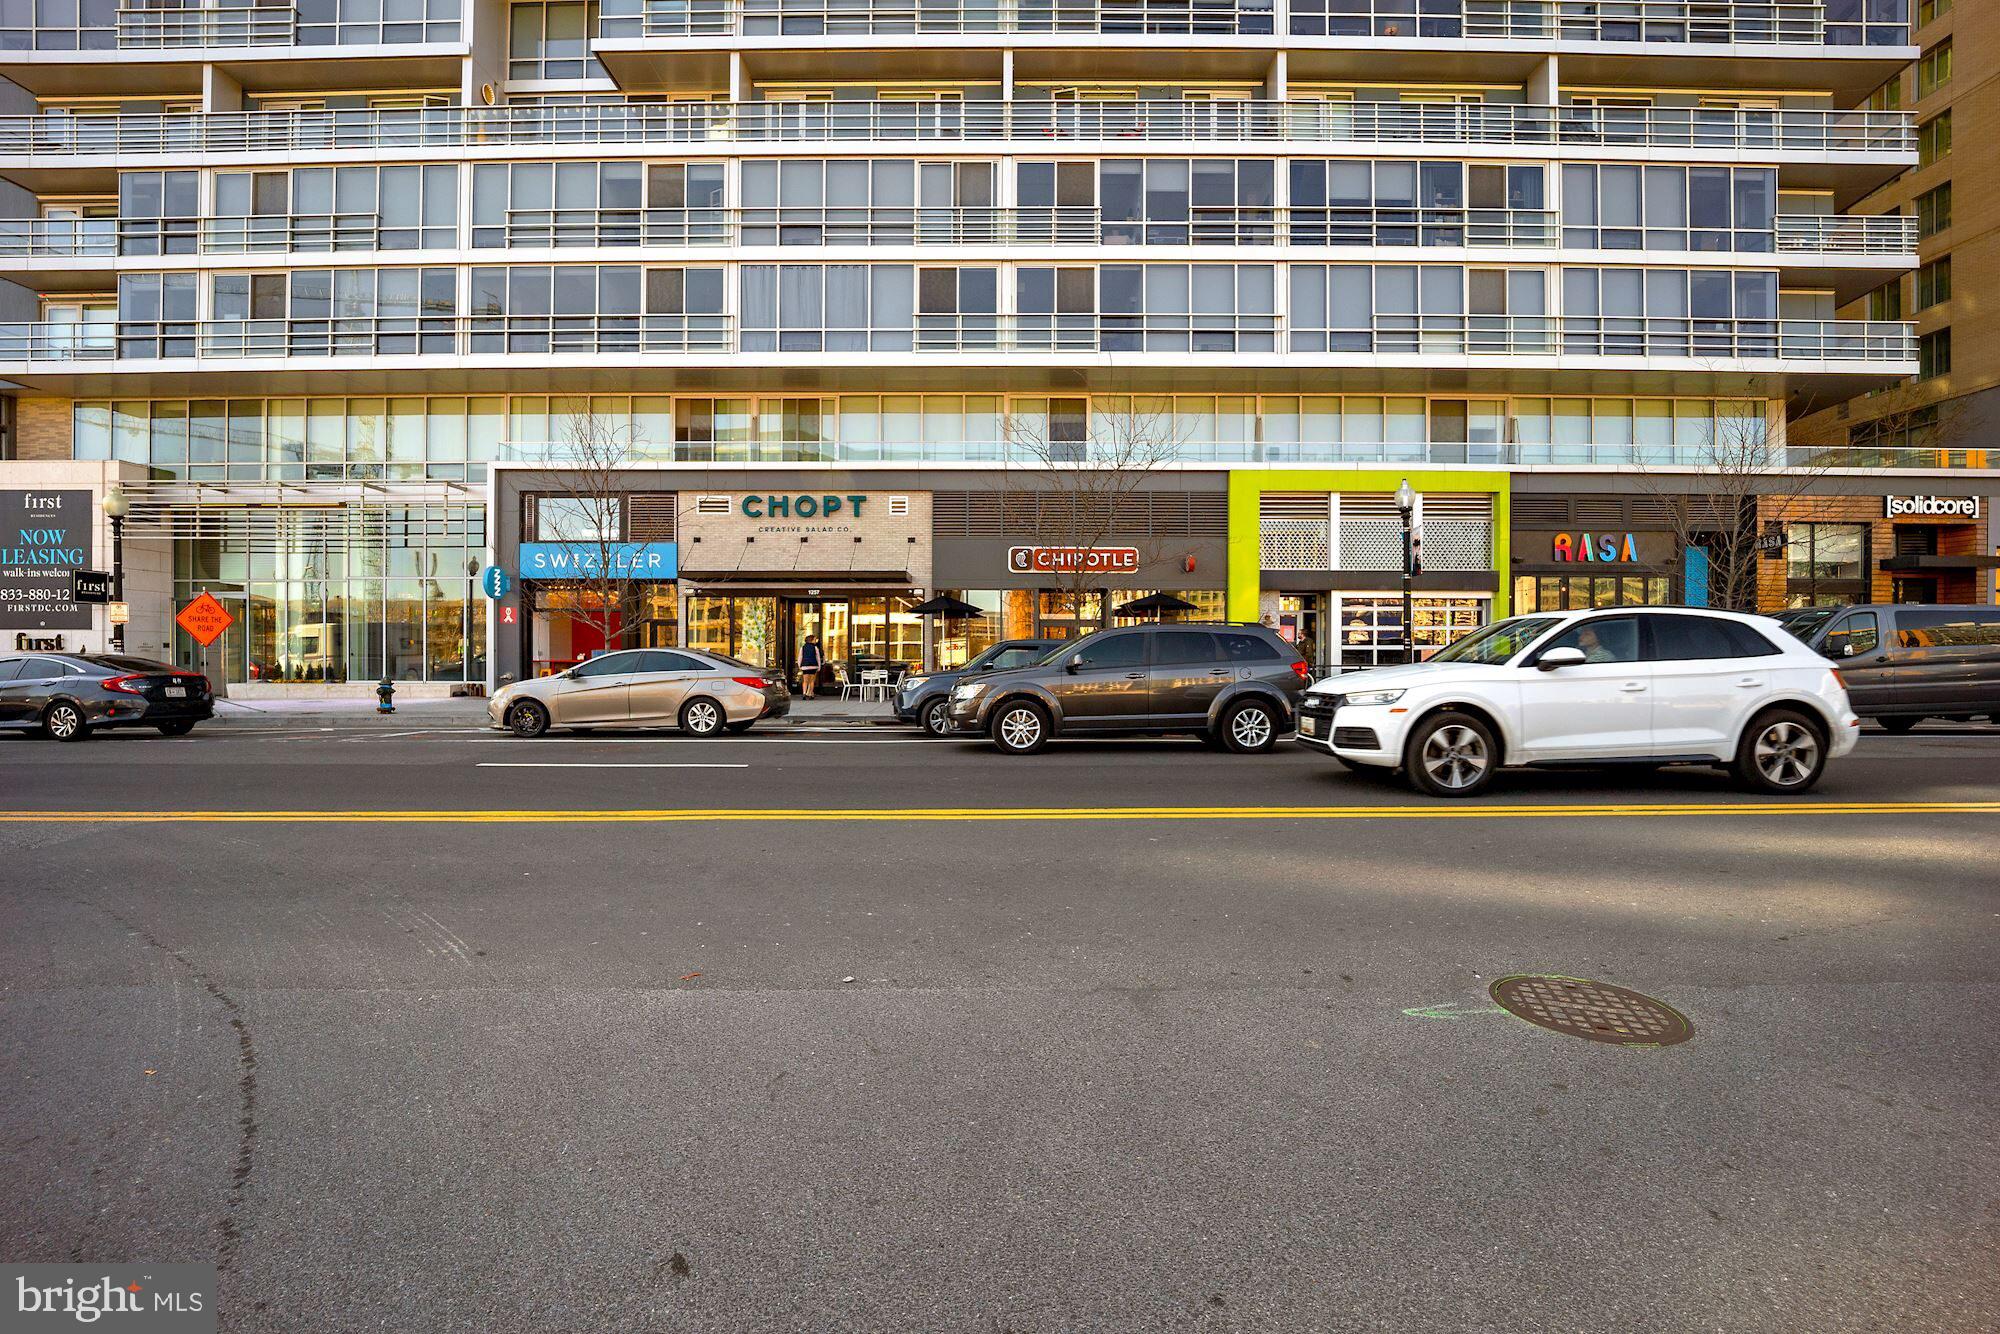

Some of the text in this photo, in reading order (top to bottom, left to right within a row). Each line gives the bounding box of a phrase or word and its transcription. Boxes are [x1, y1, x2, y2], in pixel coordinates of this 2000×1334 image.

[24, 493, 62, 509] first
[741, 495, 867, 517] CHOPT
[19, 529, 66, 545] NOW
[1552, 533, 1638, 562] RASA
[1, 548, 84, 565] LEASING
[1037, 552, 1134, 567] CHIPOTLE
[3, 568, 70, 577] walk-ins welco
[77, 579, 106, 593] first
[0, 588, 70, 601] 833-880-12
[7, 604, 78, 612] FIRSTDC.COM
[197, 624, 215, 632] ROAD
[15, 632, 65, 650] first
